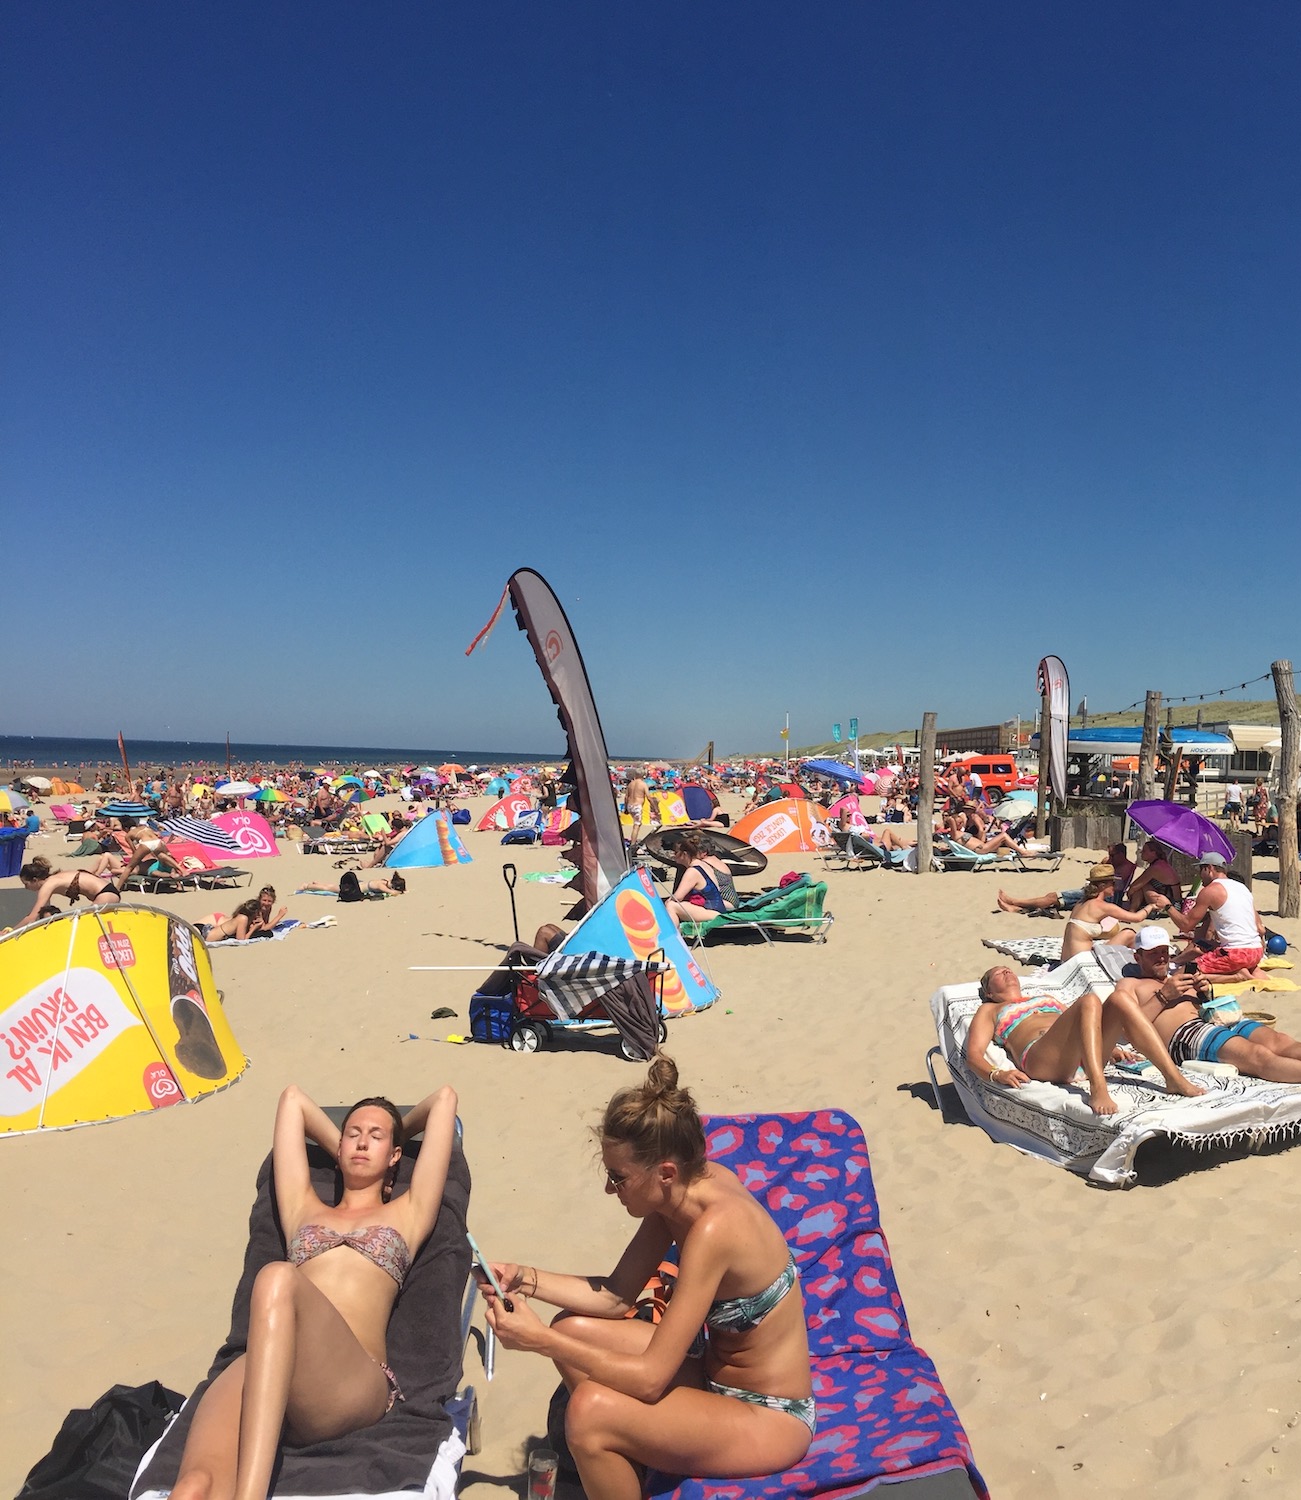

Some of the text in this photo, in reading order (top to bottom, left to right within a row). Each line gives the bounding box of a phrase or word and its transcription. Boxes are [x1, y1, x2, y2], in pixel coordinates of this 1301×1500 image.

[102, 949, 135, 964] LEKER
[6, 1003, 109, 1093] BEN IK AL
[151, 1069, 167, 1079] OLA
